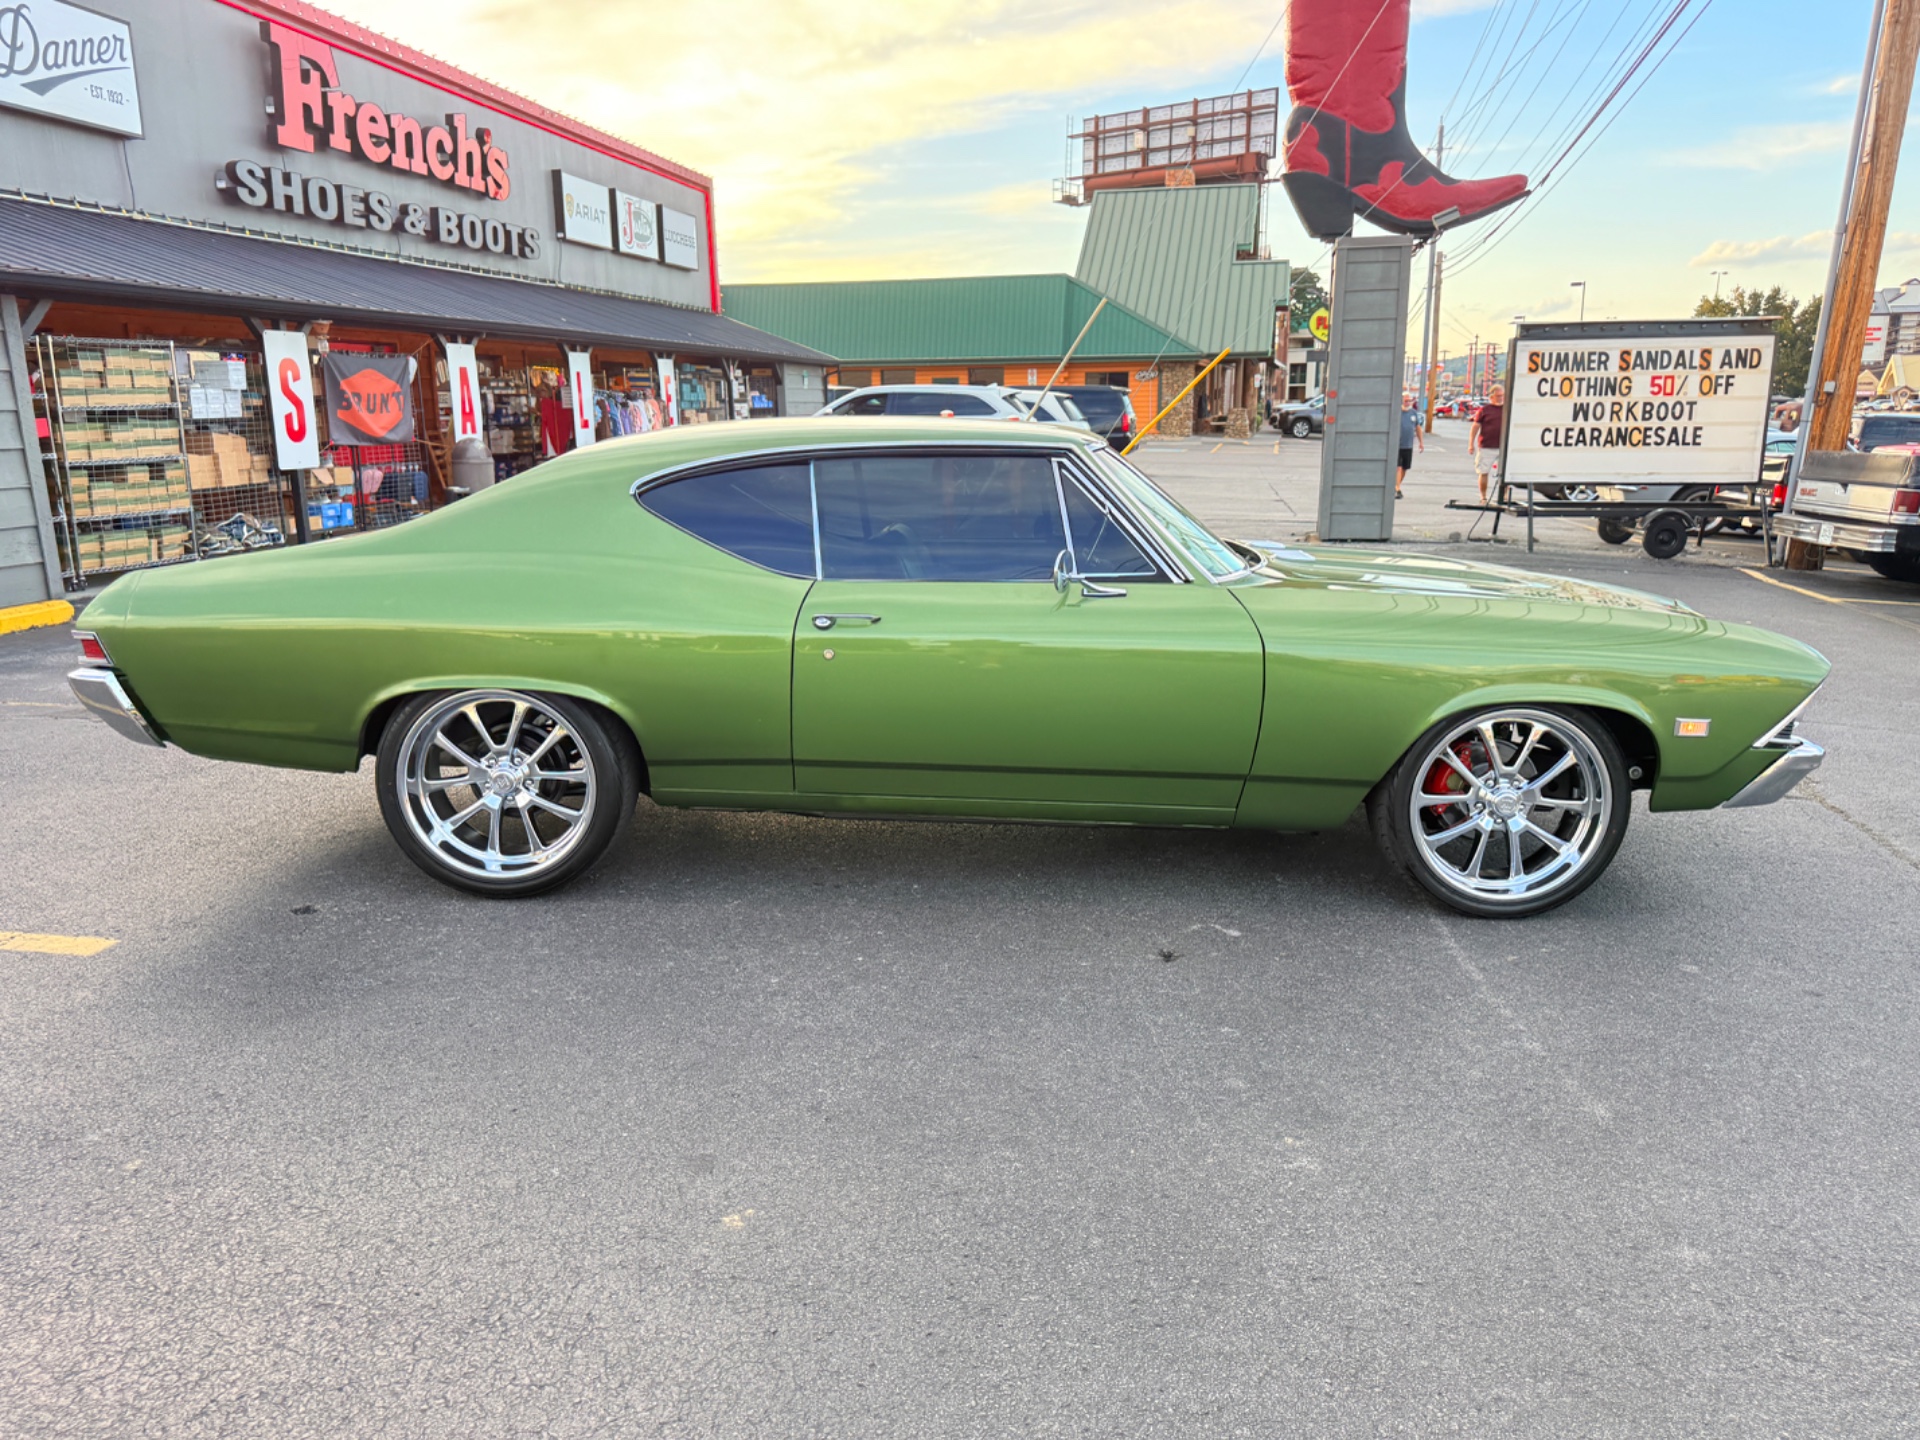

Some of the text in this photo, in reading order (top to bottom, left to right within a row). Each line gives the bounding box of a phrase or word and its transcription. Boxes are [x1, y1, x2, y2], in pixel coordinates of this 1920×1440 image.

[0, 4, 127, 78] Danner
[90, 84, 124, 105] EST. 1932
[264, 21, 511, 201] French's
[233, 160, 541, 260] SHOES & BOOTS
[575, 202, 606, 224] ARIAT
[1528, 348, 1762, 373] SUMMER SANDALS AND
[1537, 375, 1735, 398] CLOTHING 50% OFF
[278, 357, 307, 443] S
[340, 389, 404, 414] BRUNT
[459, 366, 477, 435] A
[575, 371, 590, 429] L
